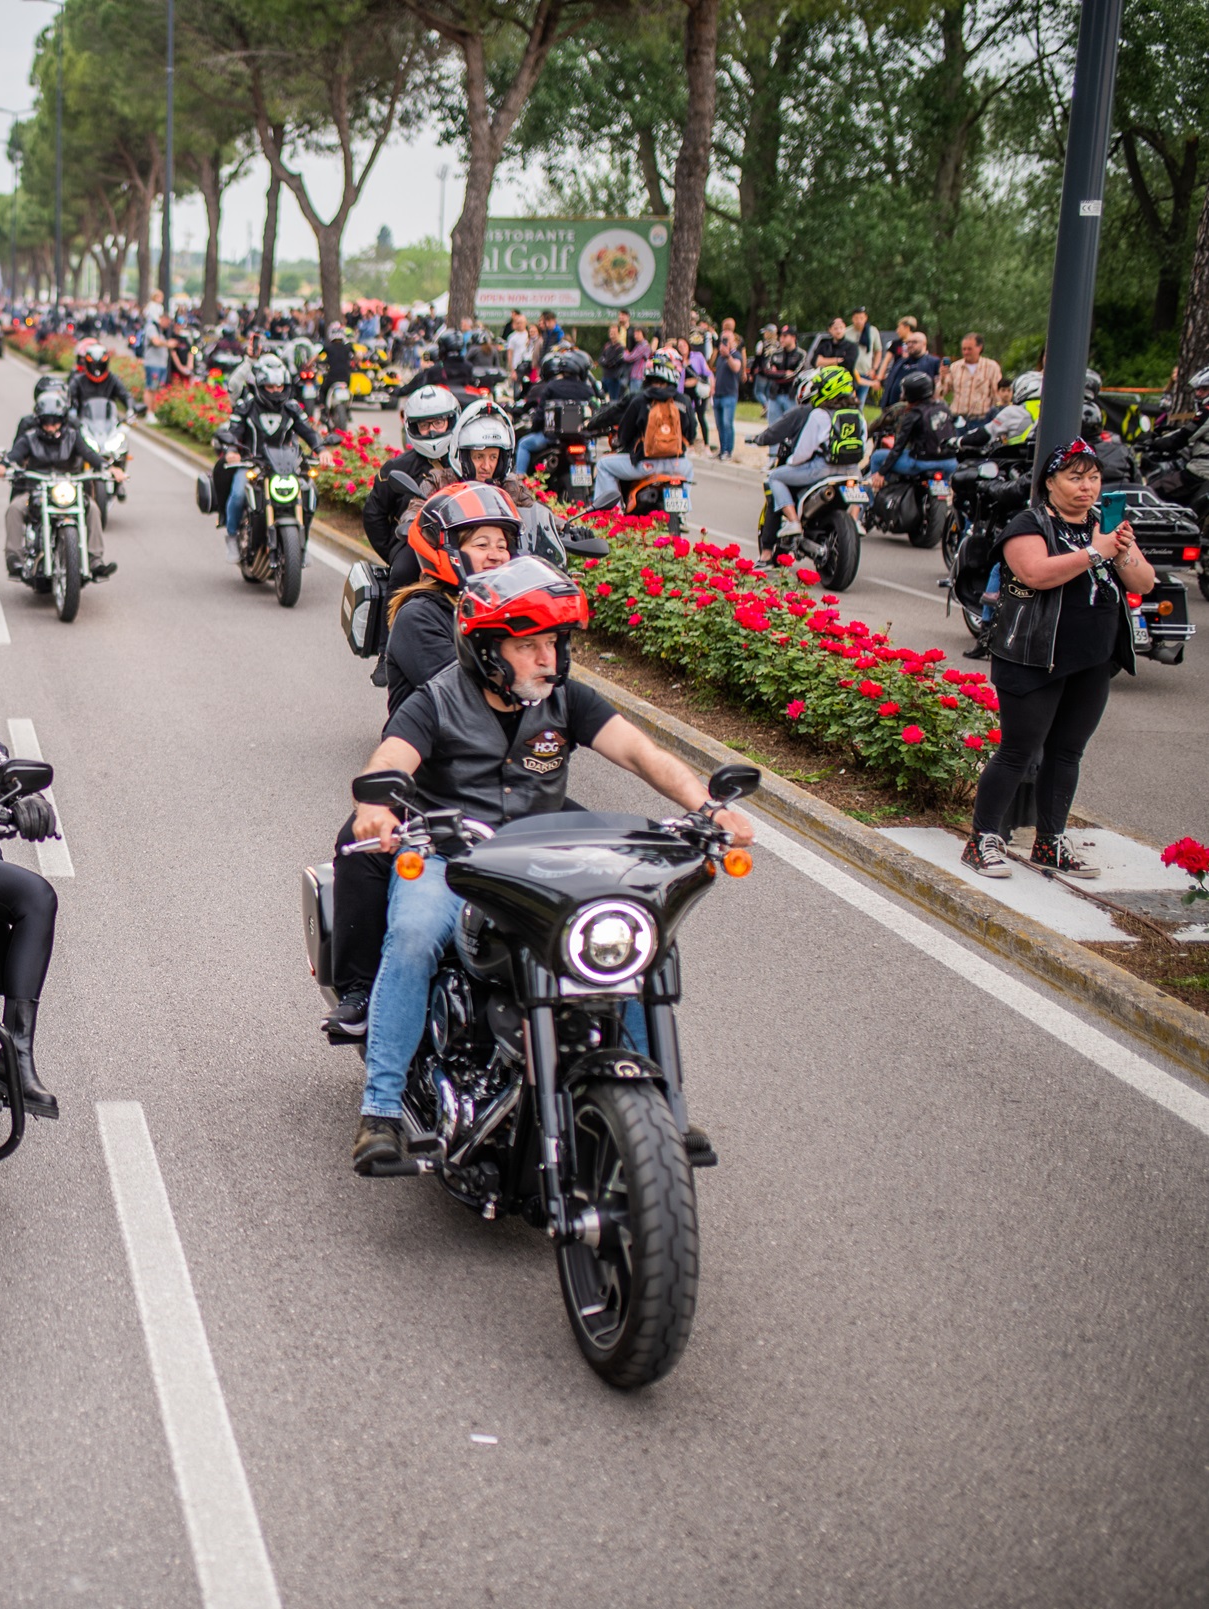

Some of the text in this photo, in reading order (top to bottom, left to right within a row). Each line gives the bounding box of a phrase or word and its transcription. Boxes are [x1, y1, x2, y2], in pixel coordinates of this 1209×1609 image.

[504, 243, 575, 273] Golf
[479, 293, 504, 303] OPEN
[535, 742, 559, 753] HOG
[528, 760, 558, 772] DARIO
